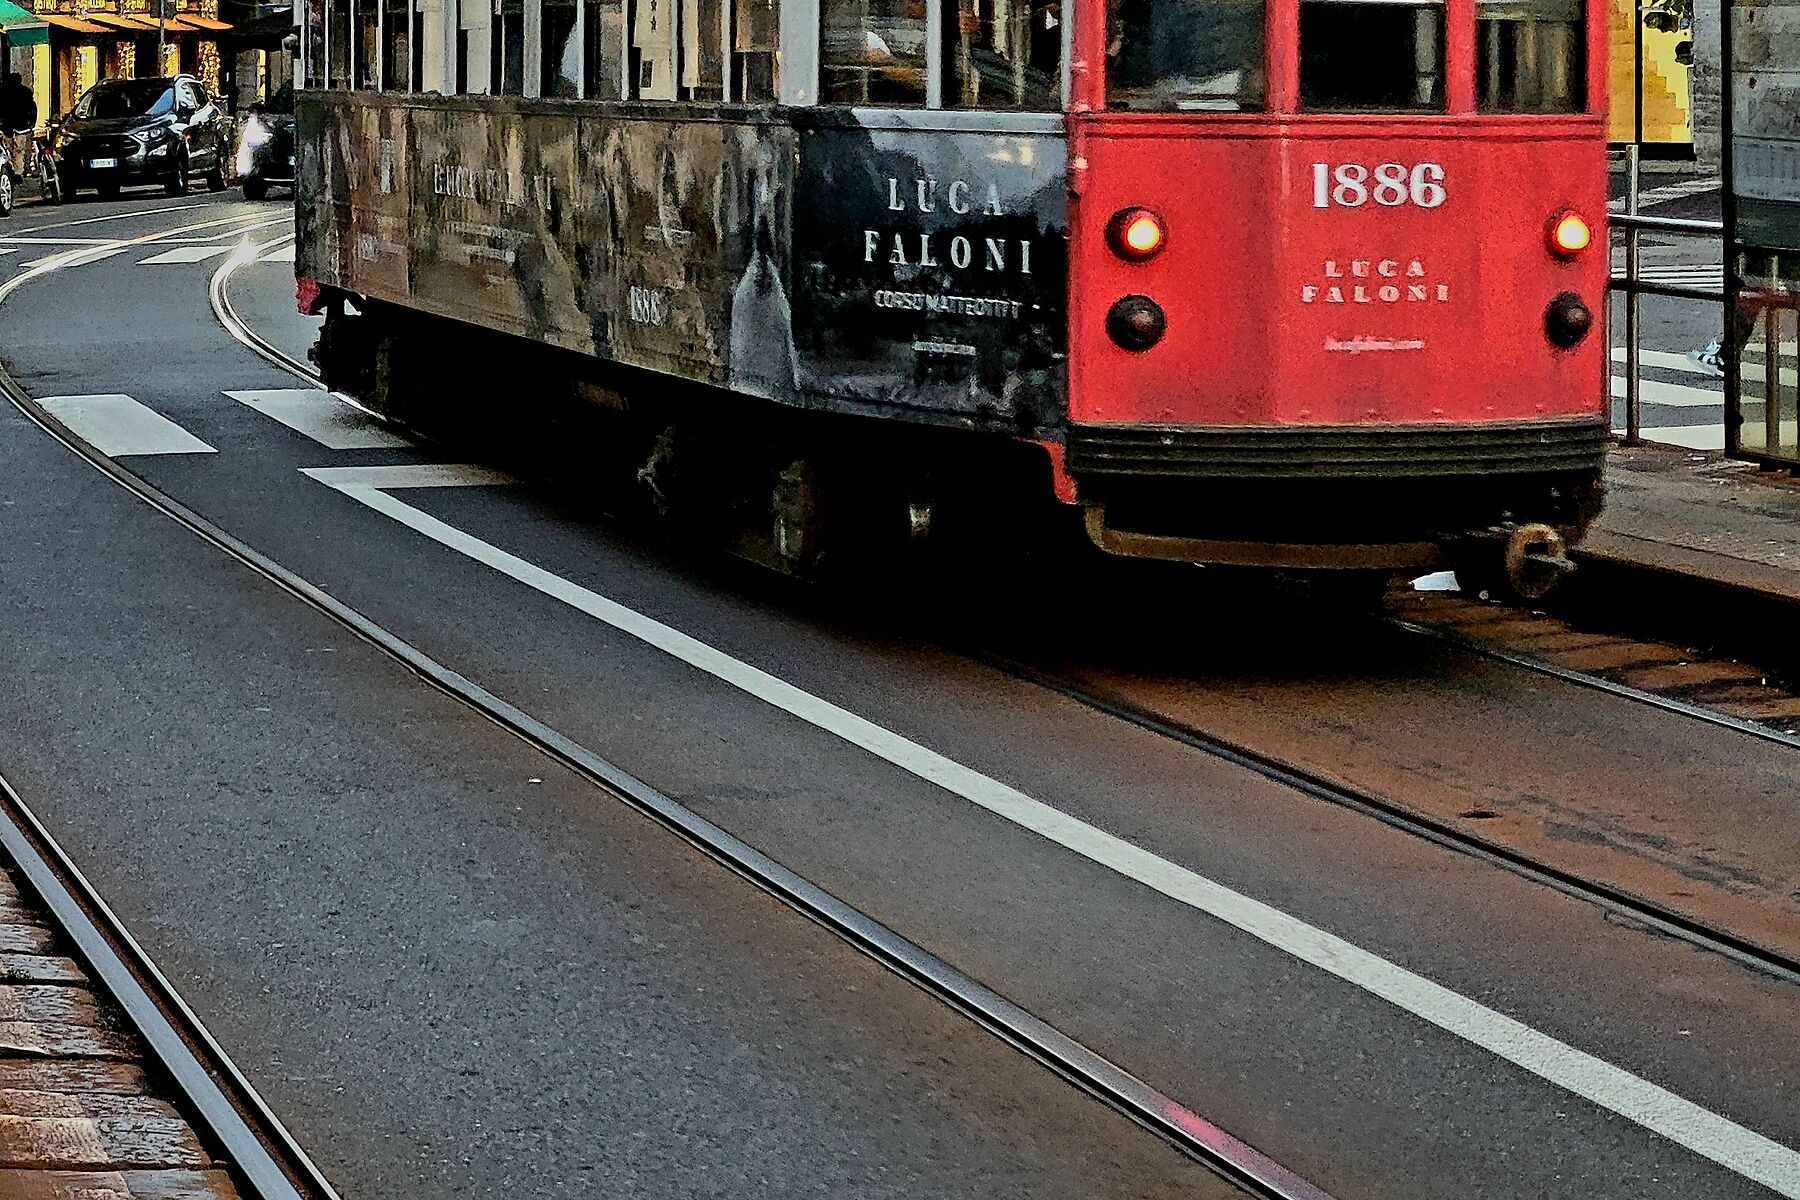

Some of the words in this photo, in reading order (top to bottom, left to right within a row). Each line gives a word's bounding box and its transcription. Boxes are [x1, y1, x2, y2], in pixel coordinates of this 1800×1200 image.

[887, 177, 1002, 215] LUCA
[1312, 162, 1447, 208] 1886
[863, 229, 1031, 274] FALONI
[1325, 259, 1425, 278] LUCA
[1302, 285, 1449, 303] FALONI
